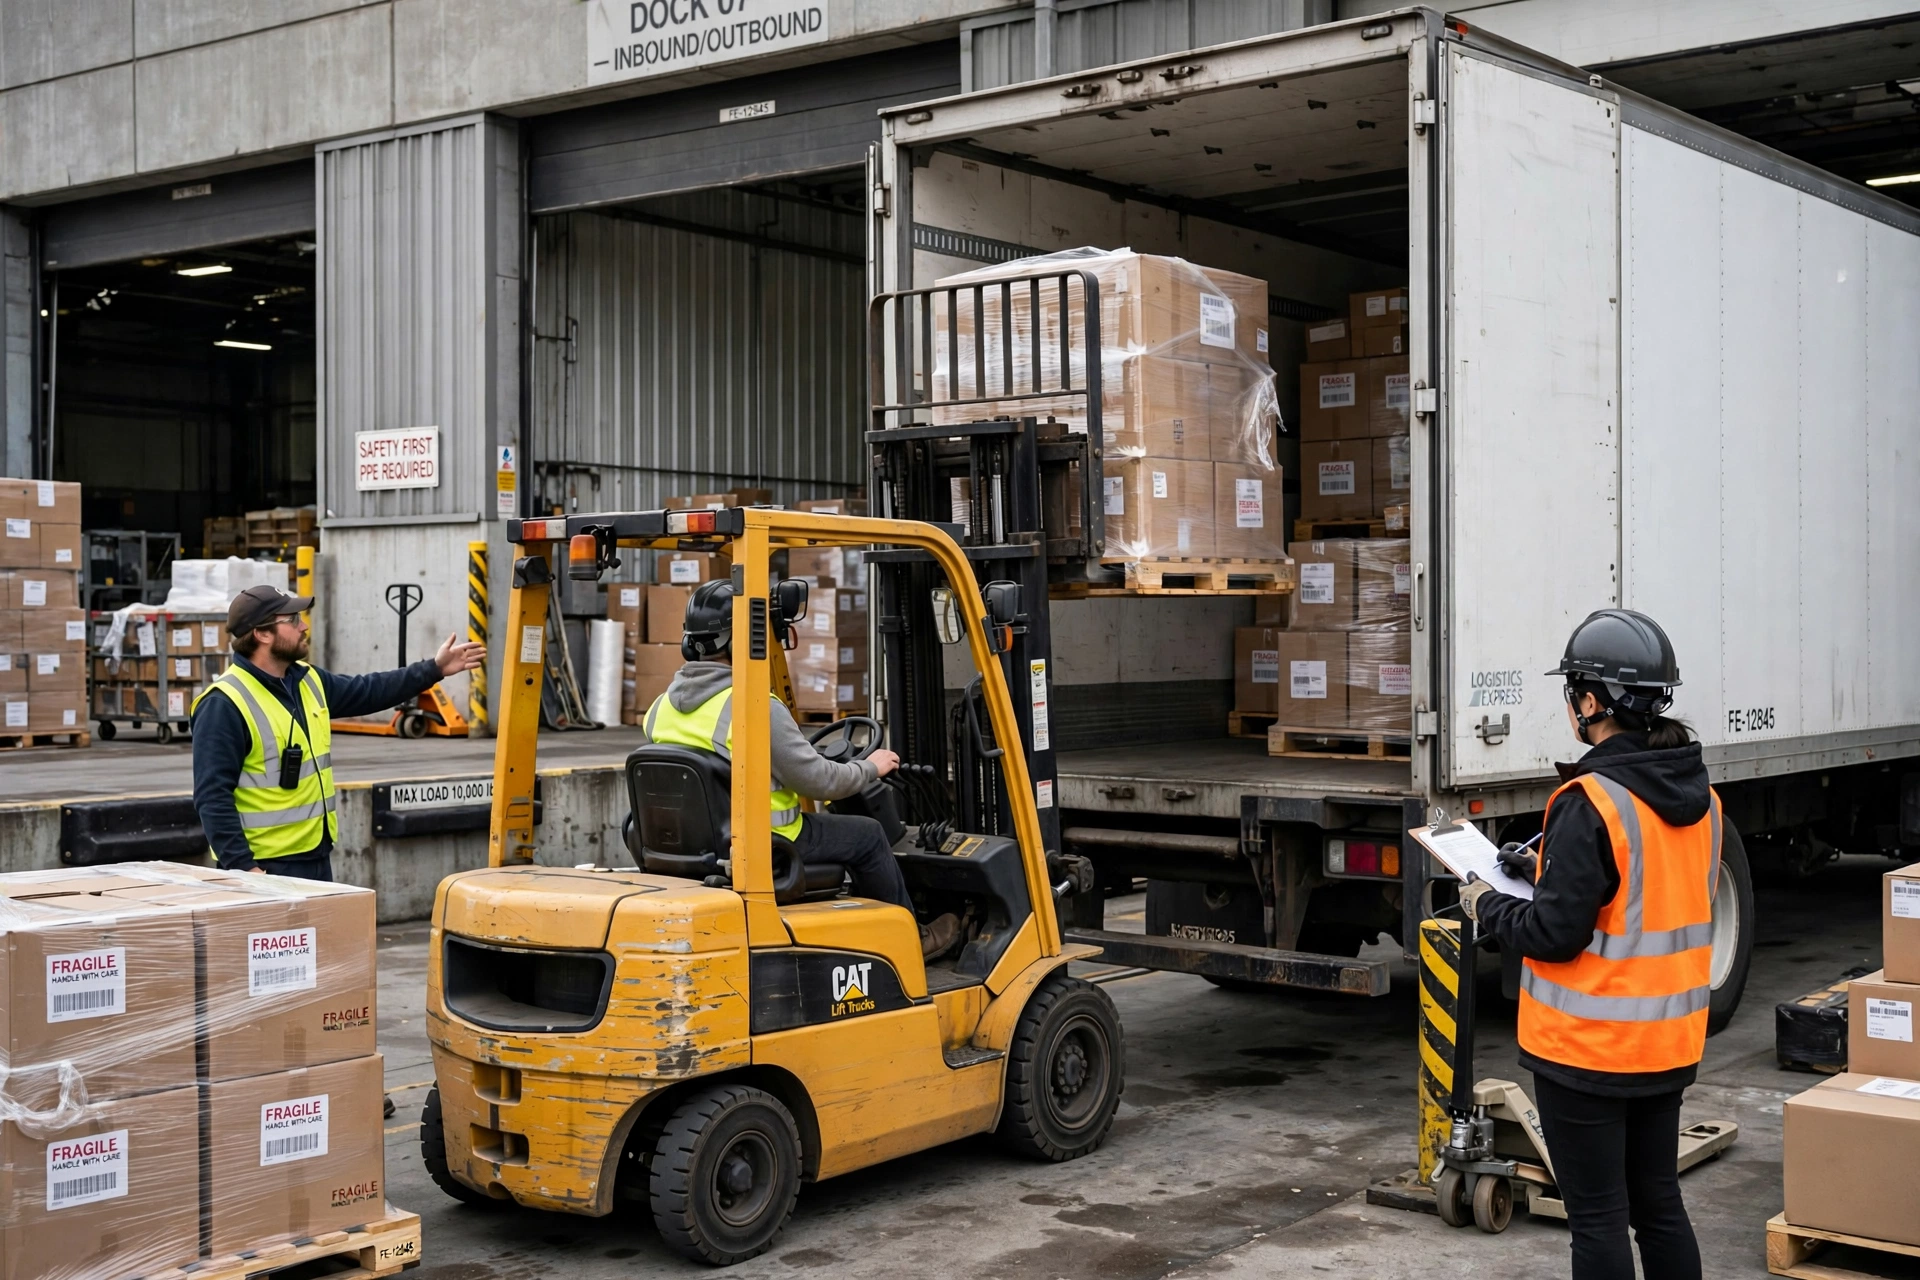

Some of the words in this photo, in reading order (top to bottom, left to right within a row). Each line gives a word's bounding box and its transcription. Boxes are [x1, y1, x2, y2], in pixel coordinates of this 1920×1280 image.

[630, 0, 709, 34] DOCK
[614, 7, 822, 71] INBOUND/OUTBOUND
[360, 439, 399, 458] SAFETY
[402, 437, 432, 456] FIRST
[360, 464, 378, 482] PPE
[382, 460, 434, 480] REQUIRED
[1471, 670, 1523, 688] LOGISTICS
[1481, 688, 1523, 707] EXPRESS
[394, 788, 418, 804] MAX
[420, 786, 449, 802] LOAD
[452, 783, 484, 801] 10,000
[253, 934, 308, 951] FRAGILE
[52, 955, 117, 974] FRAGILE
[52, 973, 80, 984] HANDLE
[81, 972, 99, 981] WITH
[101, 969, 119, 978] CARE
[832, 962, 872, 1002] CAT
[323, 1006, 369, 1025] FRAGILE
[831, 1002, 846, 1017] Lift
[847, 998, 876, 1014] Trucks
[266, 1100, 321, 1121] FRAGILE
[52, 1137, 118, 1162] FRAGILE
[82, 1157, 100, 1166] WITH
[332, 1180, 378, 1201] FRAGILE
